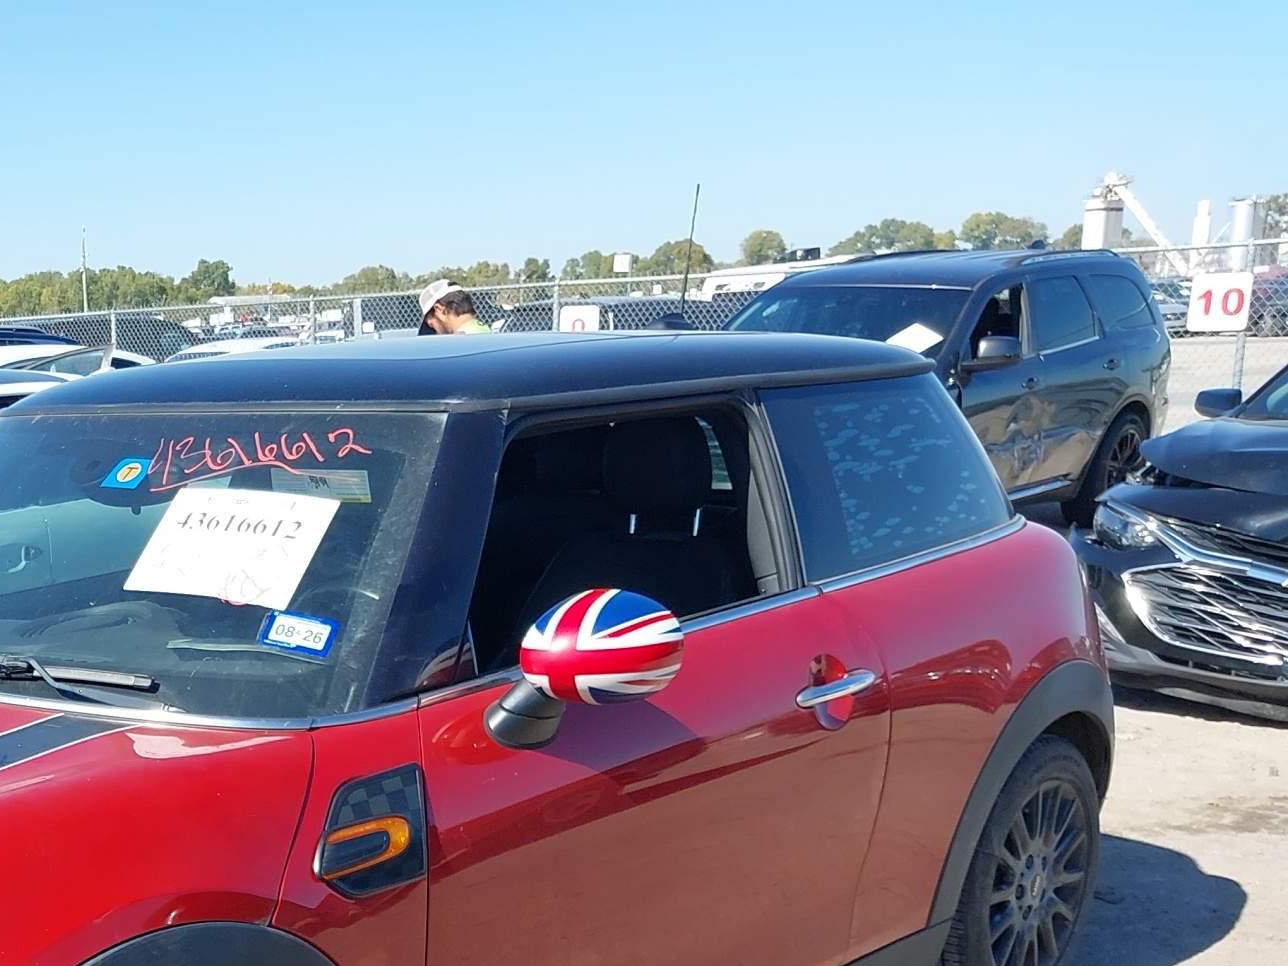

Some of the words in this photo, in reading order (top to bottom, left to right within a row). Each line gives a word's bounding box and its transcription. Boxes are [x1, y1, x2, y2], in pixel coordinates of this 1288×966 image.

[1197, 287, 1245, 316] 10
[147, 428, 373, 485] 43616612
[176, 511, 303, 540] 43616612
